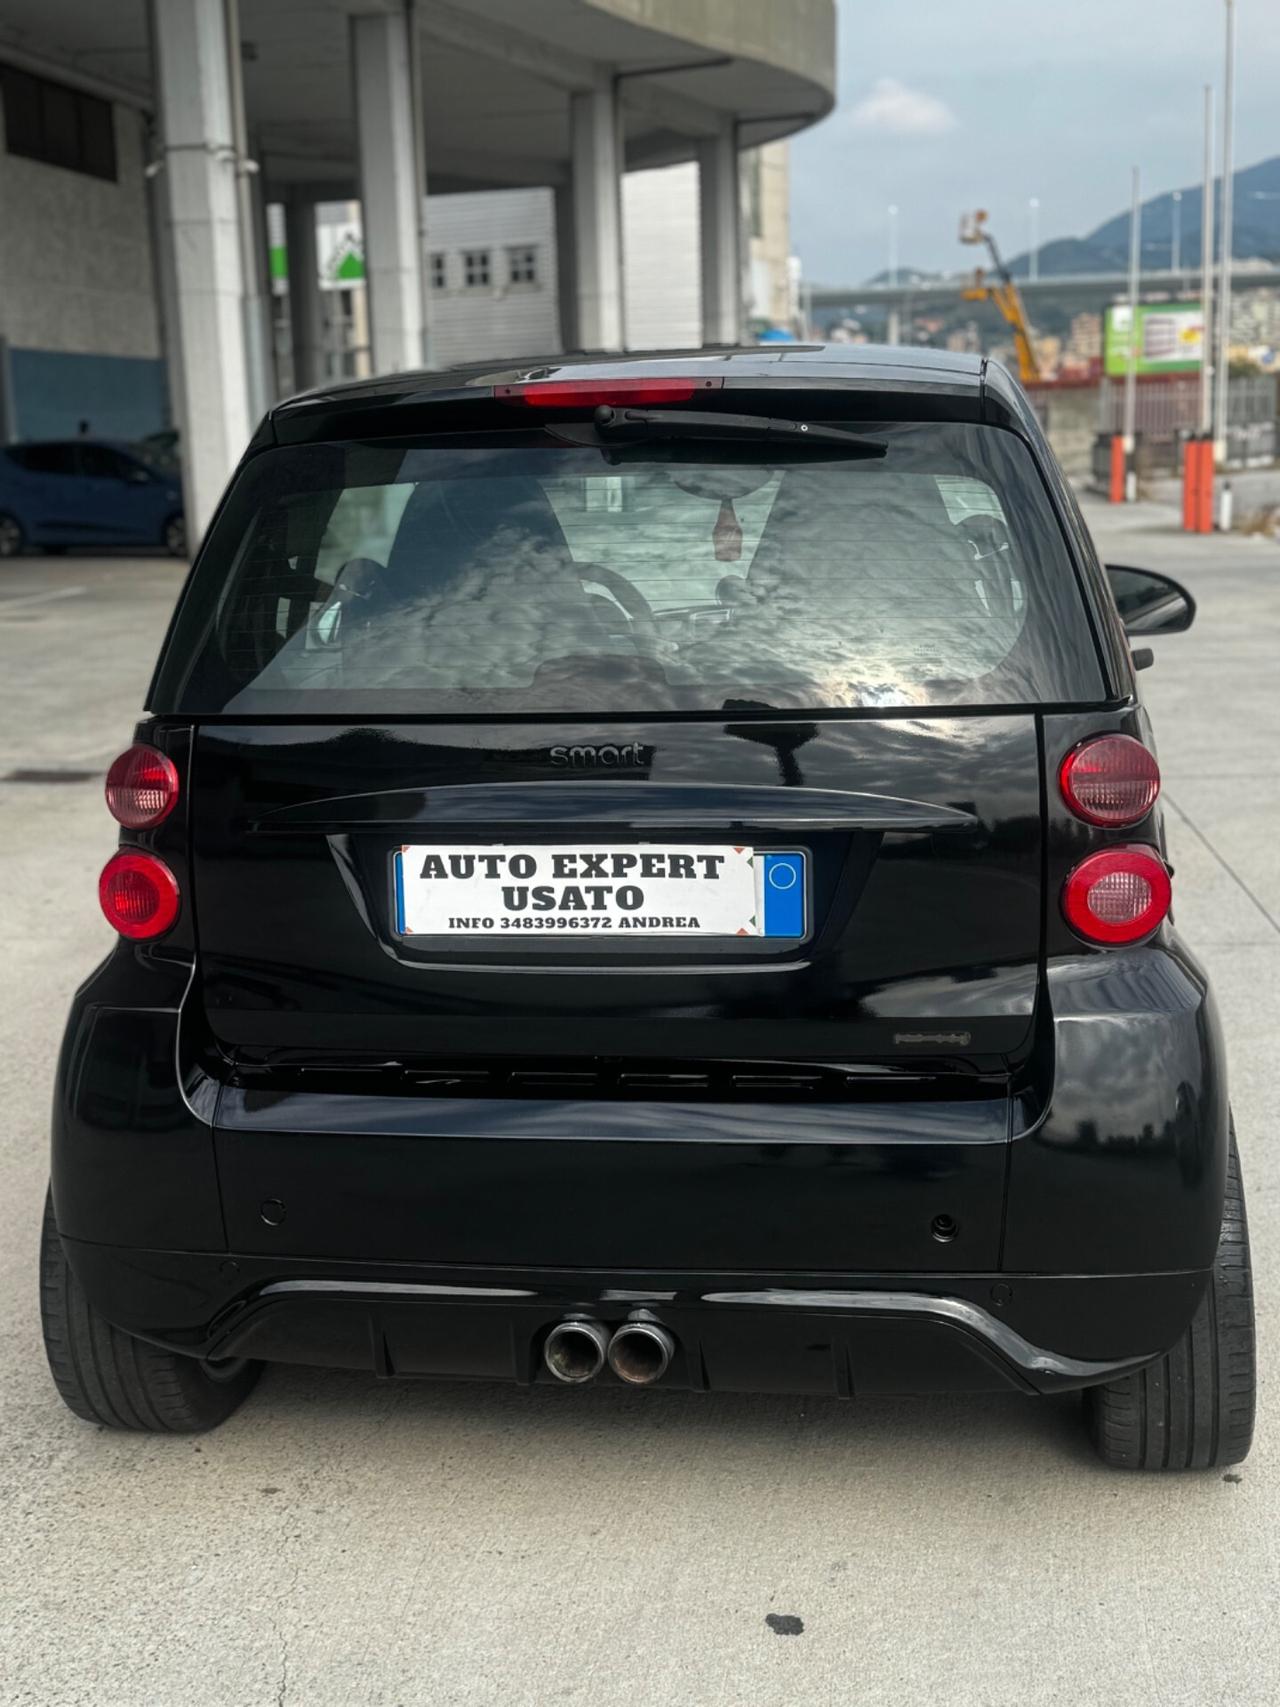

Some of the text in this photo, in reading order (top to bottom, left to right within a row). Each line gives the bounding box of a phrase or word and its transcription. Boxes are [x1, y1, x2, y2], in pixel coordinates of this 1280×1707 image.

[549, 741, 645, 767] smart
[419, 853, 725, 880] AUTO EXPERT
[501, 885, 645, 912] USATO
[448, 916, 701, 929] INFO 3483996372 ANDREA
